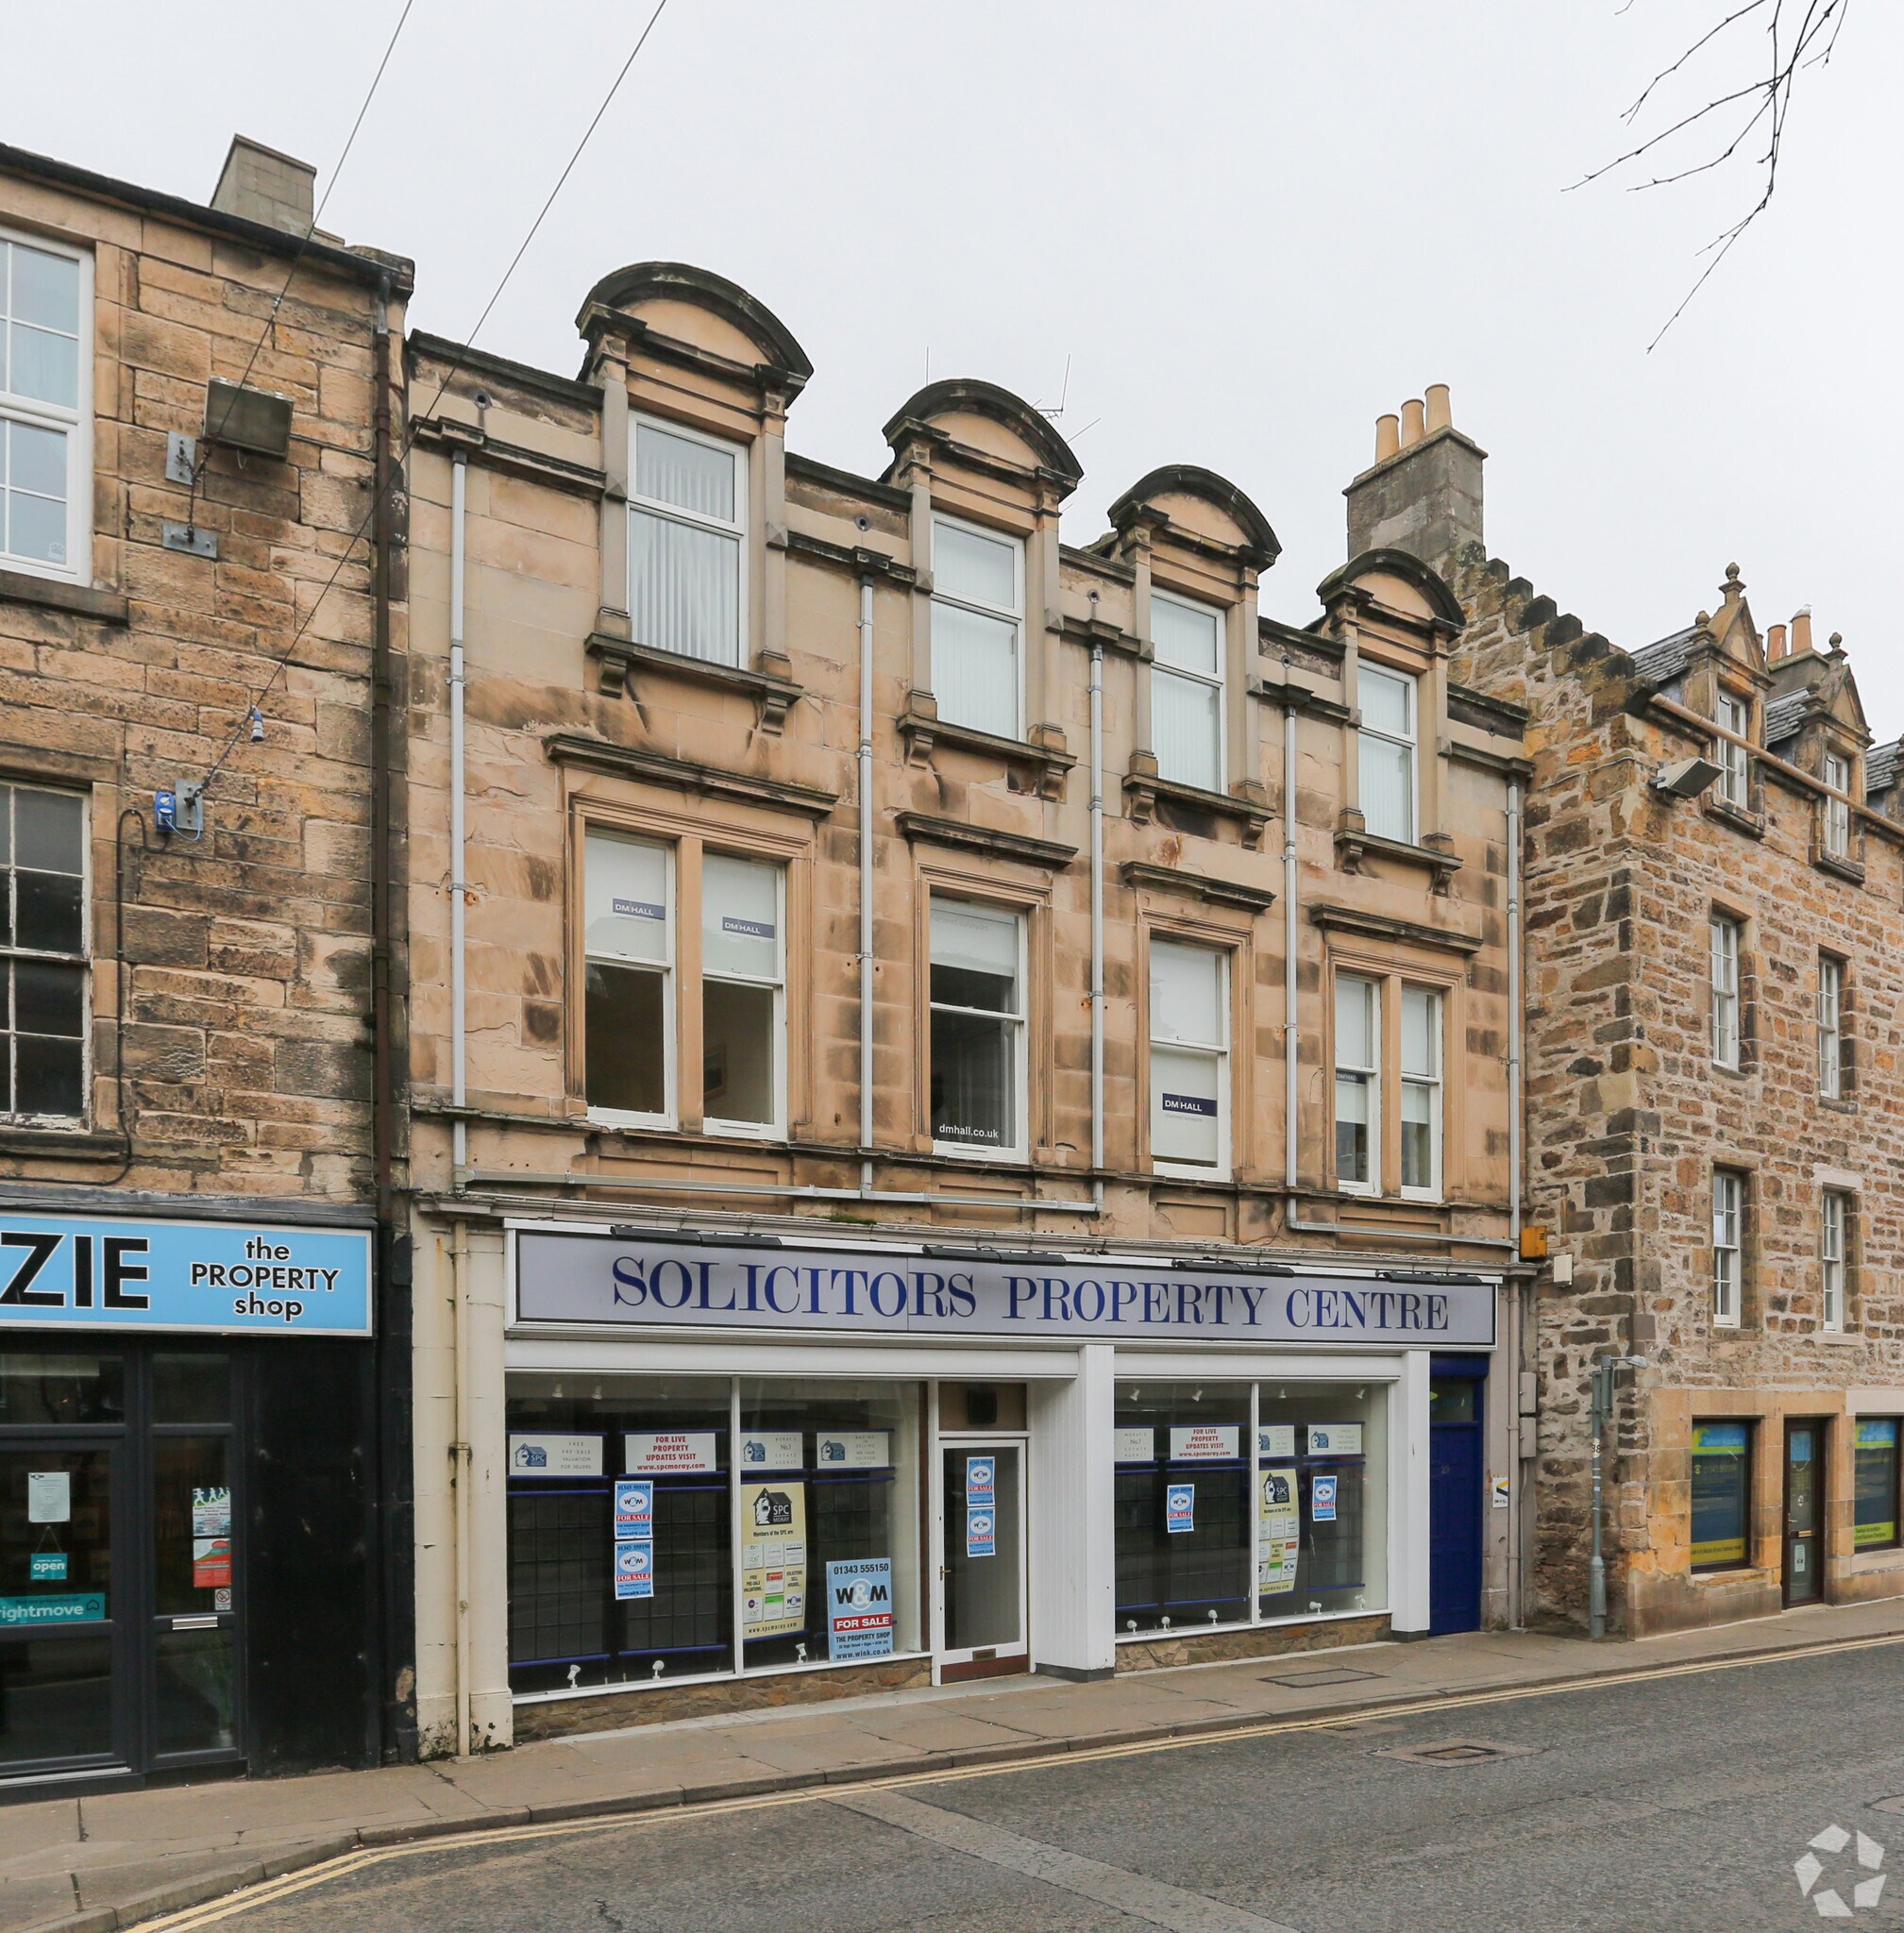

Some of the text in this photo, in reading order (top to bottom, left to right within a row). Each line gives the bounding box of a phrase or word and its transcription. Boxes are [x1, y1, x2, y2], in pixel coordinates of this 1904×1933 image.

[631, 907, 653, 916] HALL
[739, 925, 761, 933] HALL
[1165, 1100, 1203, 1112] DM HALL
[938, 1123, 999, 1138] dmhall.co.uk
[245, 1235, 291, 1261] the
[0, 1231, 150, 1310] ZIE
[191, 1263, 341, 1291] PROPERTY
[612, 1256, 1449, 1331] SOLICITORS PROPERTY CENTRE
[234, 1291, 303, 1321] shop
[1276, 1487, 1288, 1495] SPC
[772, 1504, 789, 1516] SPC
[33, 1562, 65, 1572] open
[834, 1563, 889, 1575] 01343 555150
[835, 1584, 888, 1605] W&M
[836, 1617, 889, 1629] FOR SALE
[847, 1633, 875, 1642] PROPERTY
[836, 1648, 891, 1659] www.wink.co.uk
